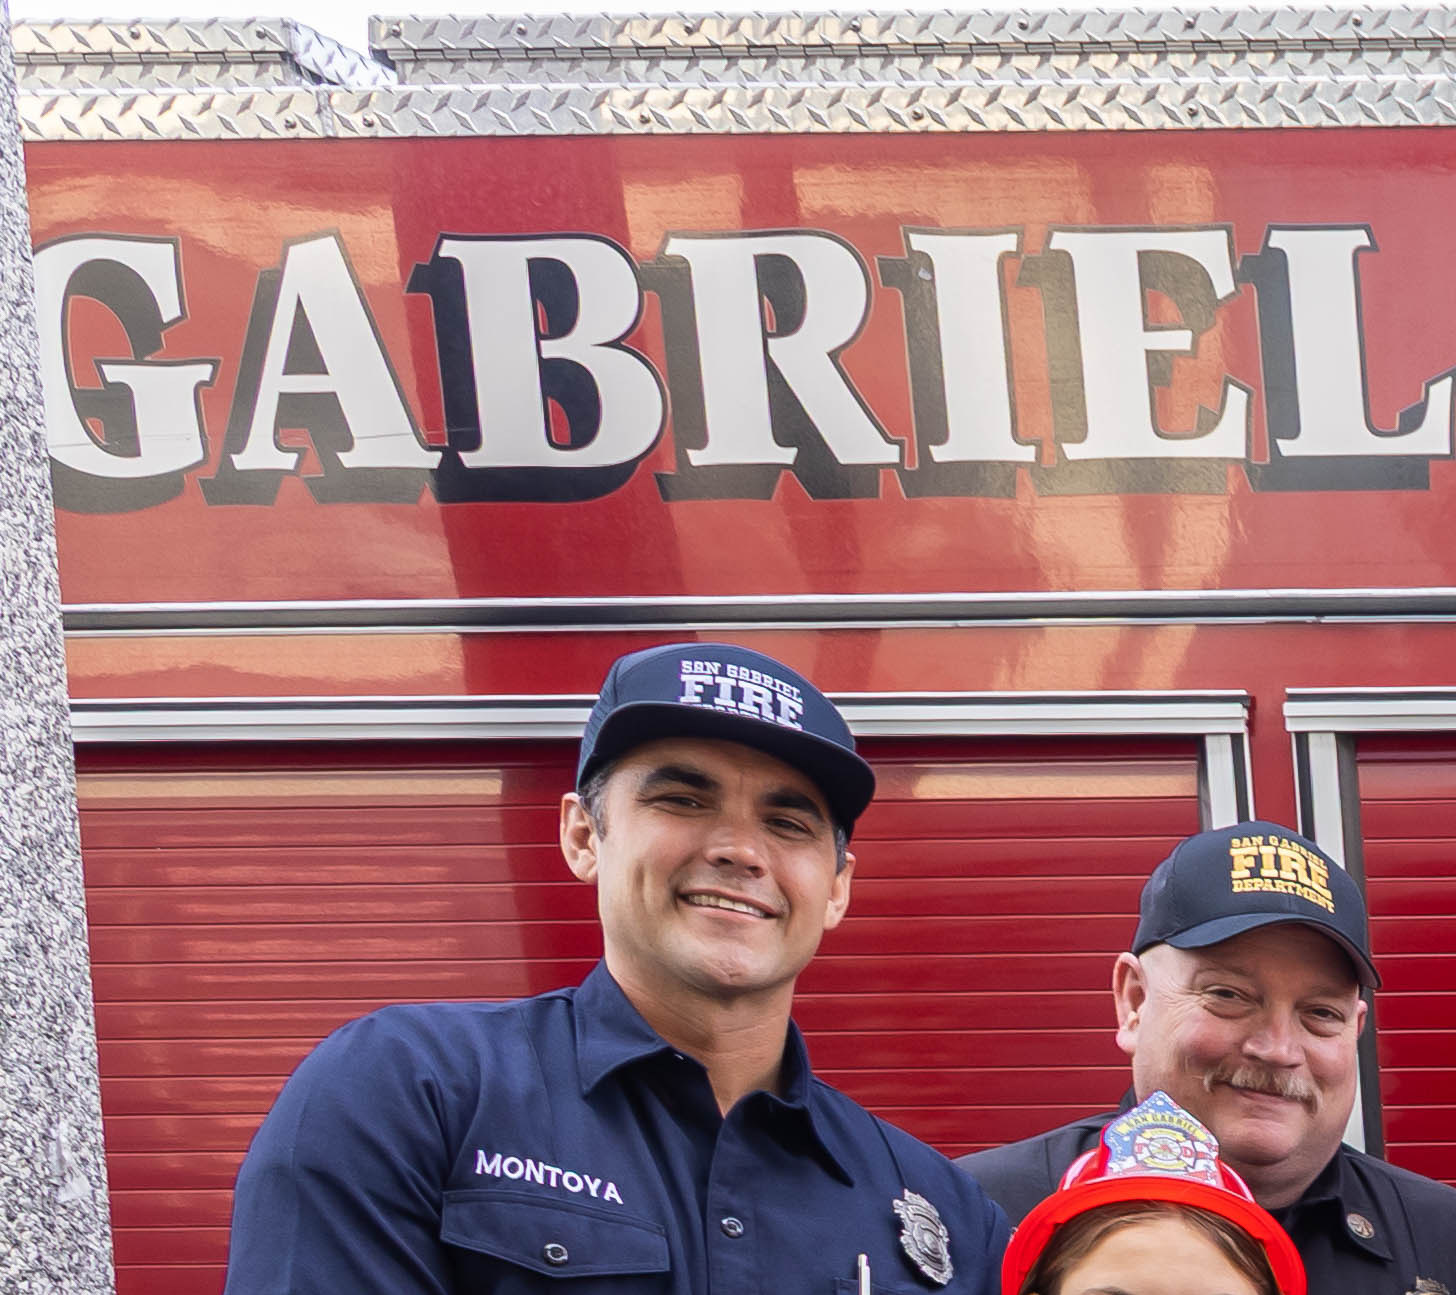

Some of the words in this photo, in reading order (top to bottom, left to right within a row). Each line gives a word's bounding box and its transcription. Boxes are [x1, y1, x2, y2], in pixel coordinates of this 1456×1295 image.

[32, 224, 1456, 505] GABRIEL
[679, 674, 803, 731] FIRE
[680, 659, 721, 675] SAN
[727, 664, 801, 697] GABRIEL
[1230, 845, 1333, 900] FIRE
[1231, 836, 1263, 849] SAN
[1269, 835, 1328, 870] GABRIEL
[1232, 877, 1336, 914] DEPARTMENT
[474, 1150, 624, 1205] MONTOYA
